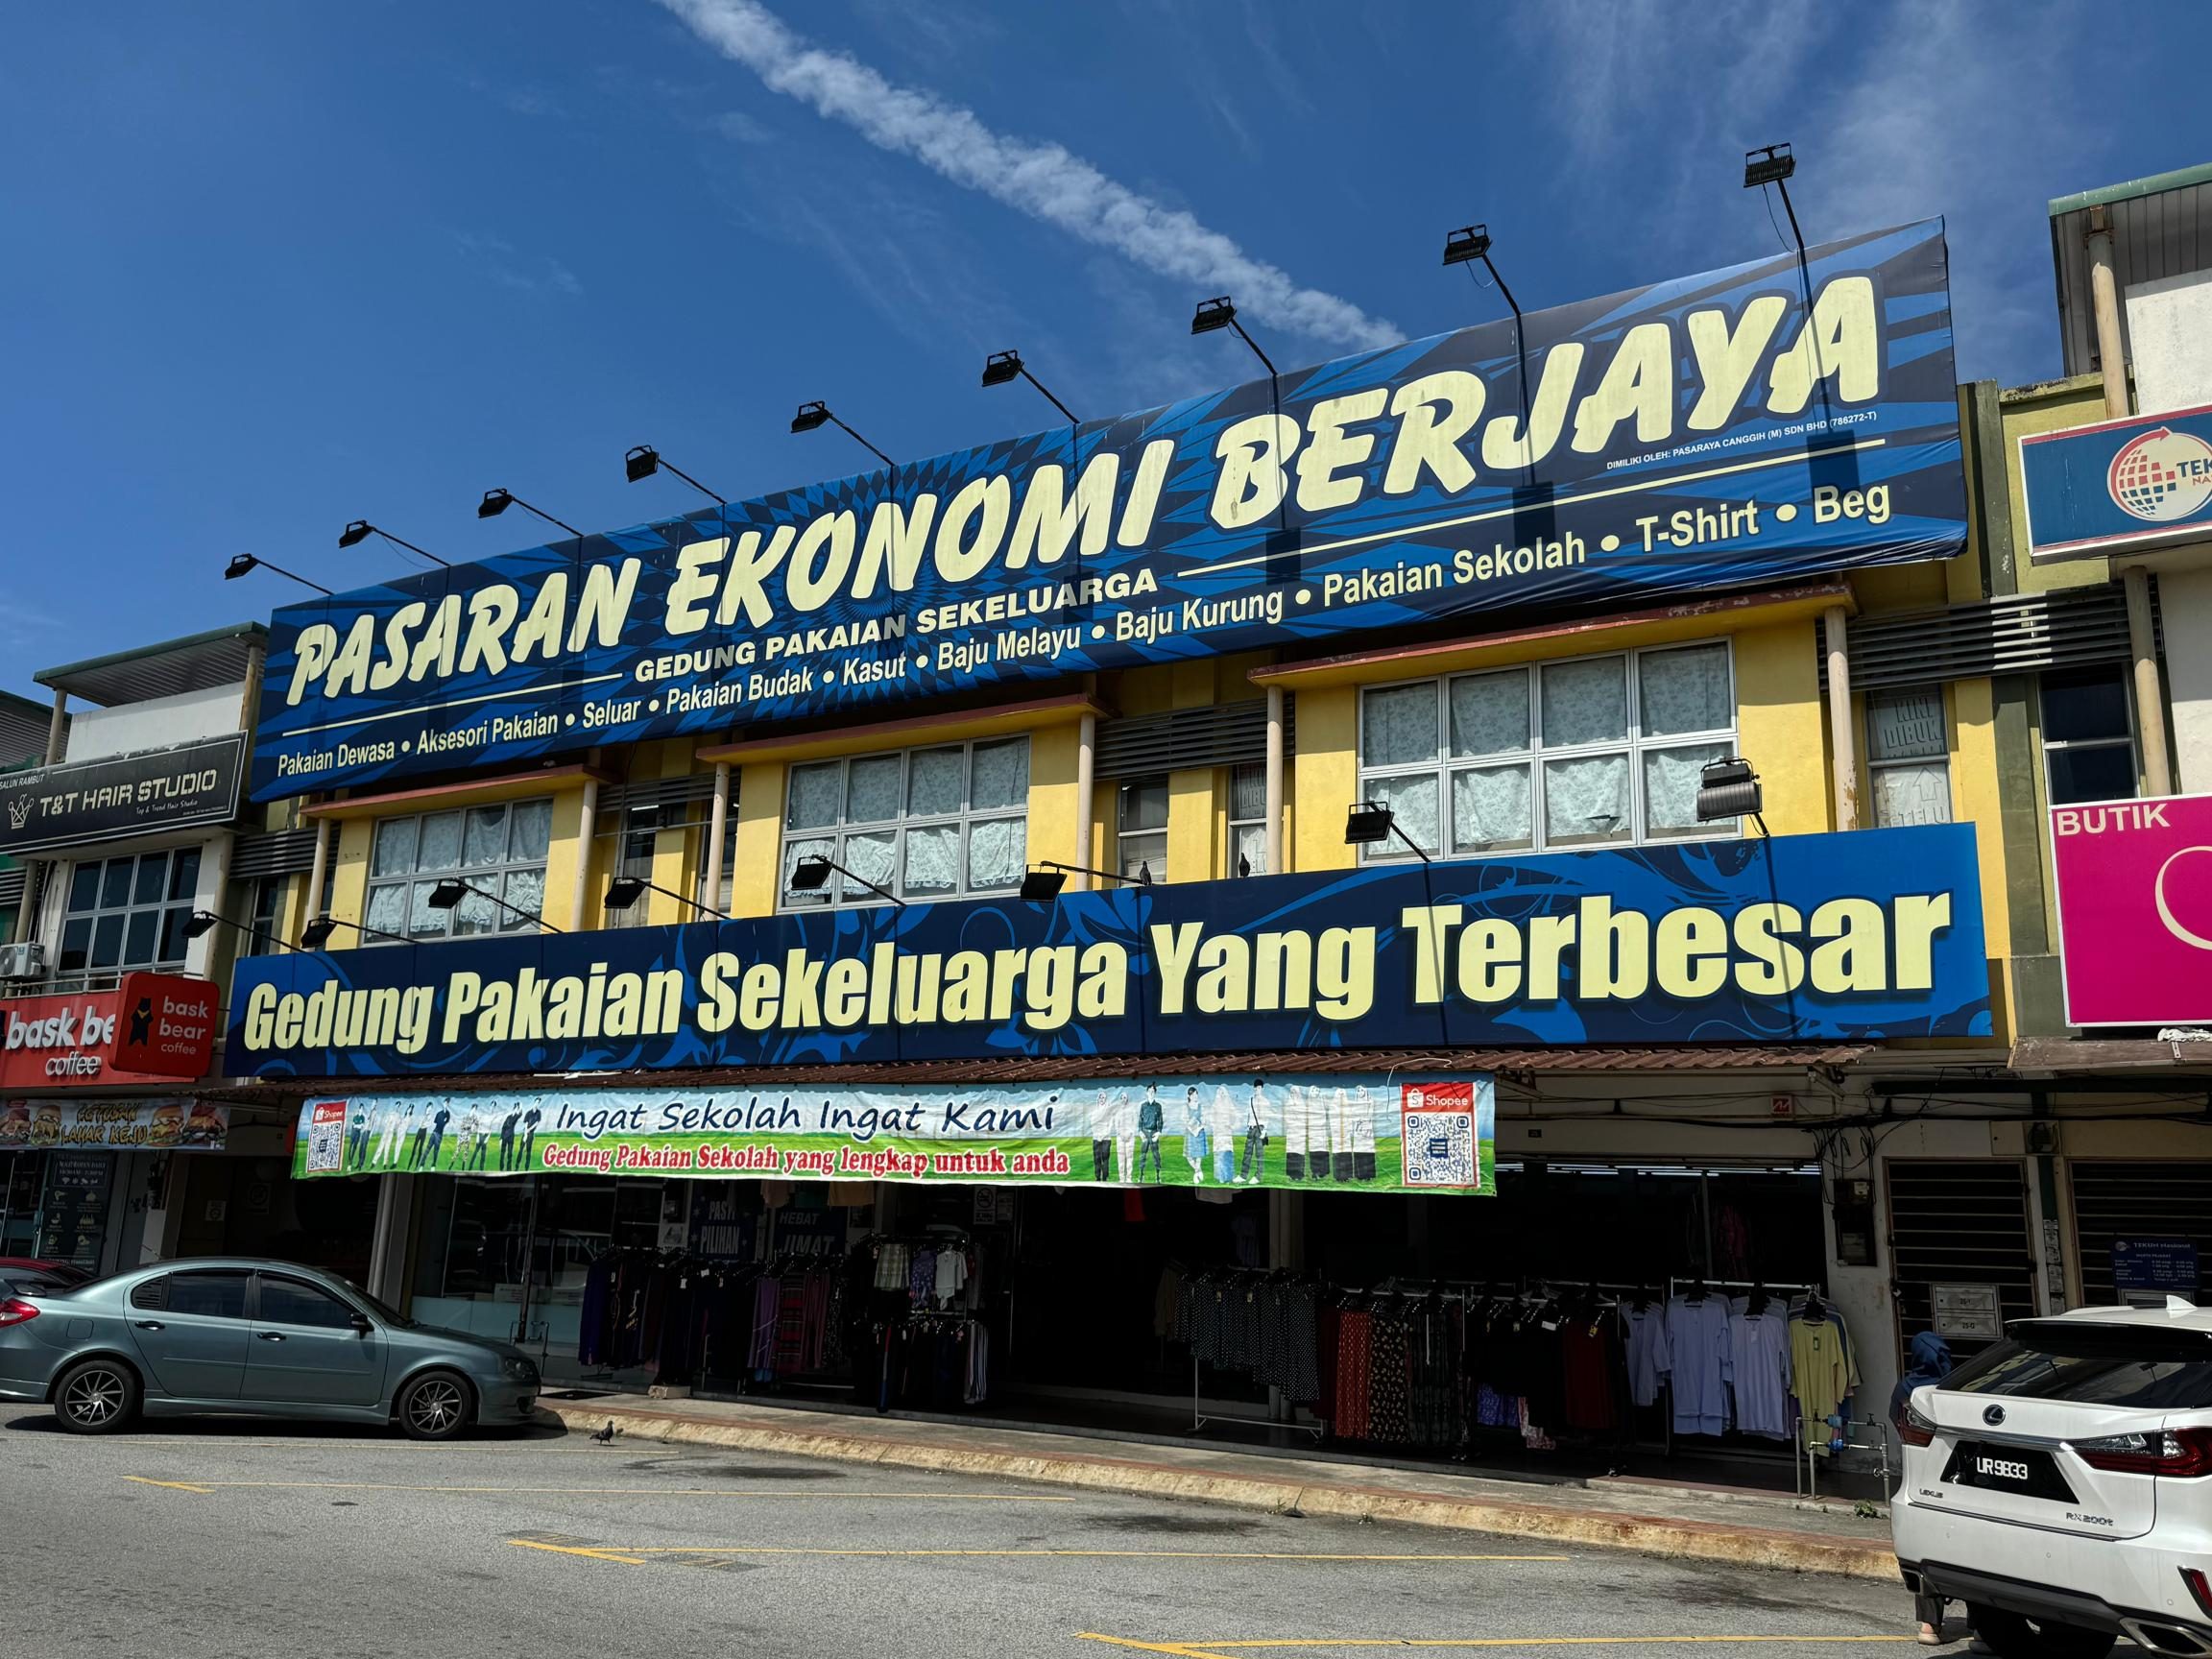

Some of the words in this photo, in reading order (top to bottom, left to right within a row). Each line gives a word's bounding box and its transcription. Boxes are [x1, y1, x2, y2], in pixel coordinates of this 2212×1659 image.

[1606, 455, 1642, 470] DIMILIKI
[1644, 450, 1671, 464] OLEH:
[1672, 439, 1721, 456] PASARAYA
[1722, 431, 1767, 447] CANGGIH
[1767, 427, 1782, 442] (M)
[1784, 424, 1805, 436] SDN
[1806, 421, 1827, 432] BHD
[1829, 411, 1877, 429] (786272-T)
[286, 558, 640, 707] PASARAN
[667, 440, 1174, 635] EKONOMI
[1210, 276, 1880, 529] BERJAYA
[277, 750, 333, 777] Pakaian
[337, 741, 395, 766] Dewasa
[417, 719, 487, 755] Aksesori
[492, 711, 558, 742] Pakaian
[582, 697, 640, 728] Seluar
[665, 683, 742, 714] Pakaian
[748, 666, 813, 701] Budak
[842, 651, 906, 685] Kasut
[937, 640, 989, 672] Baju
[997, 625, 1081, 660] Melayu
[1116, 608, 1173, 642] Baju
[1182, 589, 1284, 631] Kurung
[1323, 563, 1442, 607] Pakaian
[1453, 530, 1586, 585] Sekolah
[1636, 498, 1759, 553] T-Shirt
[1814, 485, 1890, 529] Beg
[636, 642, 756, 683] GEDUNG
[765, 614, 905, 661] PAKAIAN
[917, 568, 1158, 635] SEKELUARGA
[18, 774, 45, 787] RAMBUT
[39, 792, 78, 817] T&T
[82, 783, 132, 811] HAIR
[137, 769, 217, 803] STUDIO
[180, 799, 198, 807] Studio
[2056, 802, 2170, 836] BUTIK
[244, 979, 434, 1054] Gedung
[442, 962, 684, 1044] Pakaian
[697, 942, 1126, 1033] Sekeluarga
[1151, 922, 1376, 1021] Yang
[1402, 892, 1951, 1004] Terbesar
[162, 996, 208, 1019] bask
[5, 1007, 78, 1050] bask
[80, 1005, 115, 1046] be
[158, 1019, 205, 1041] bear
[45, 1050, 102, 1076] coffee
[160, 1041, 197, 1055] coffee
[1426, 1094, 1469, 1108] Shopee
[557, 1100, 647, 1142] Ingat
[656, 1096, 801, 1132] Sekolah
[820, 1099, 923, 1141] Ingat
[942, 1094, 1059, 1132] Kami
[543, 1142, 612, 1170] Gedung
[615, 1143, 692, 1170] Pakaian
[698, 1142, 777, 1168] Sekolah
[782, 1149, 835, 1175] yang
[840, 1145, 927, 1178] lengkap
[934, 1147, 1006, 1174] untuk
[1013, 1148, 1069, 1174] anda
[780, 1212, 821, 1226] HEBAT
[700, 1225, 740, 1255] PILIHAN
[1919, 1488, 1943, 1499] LEXUS
